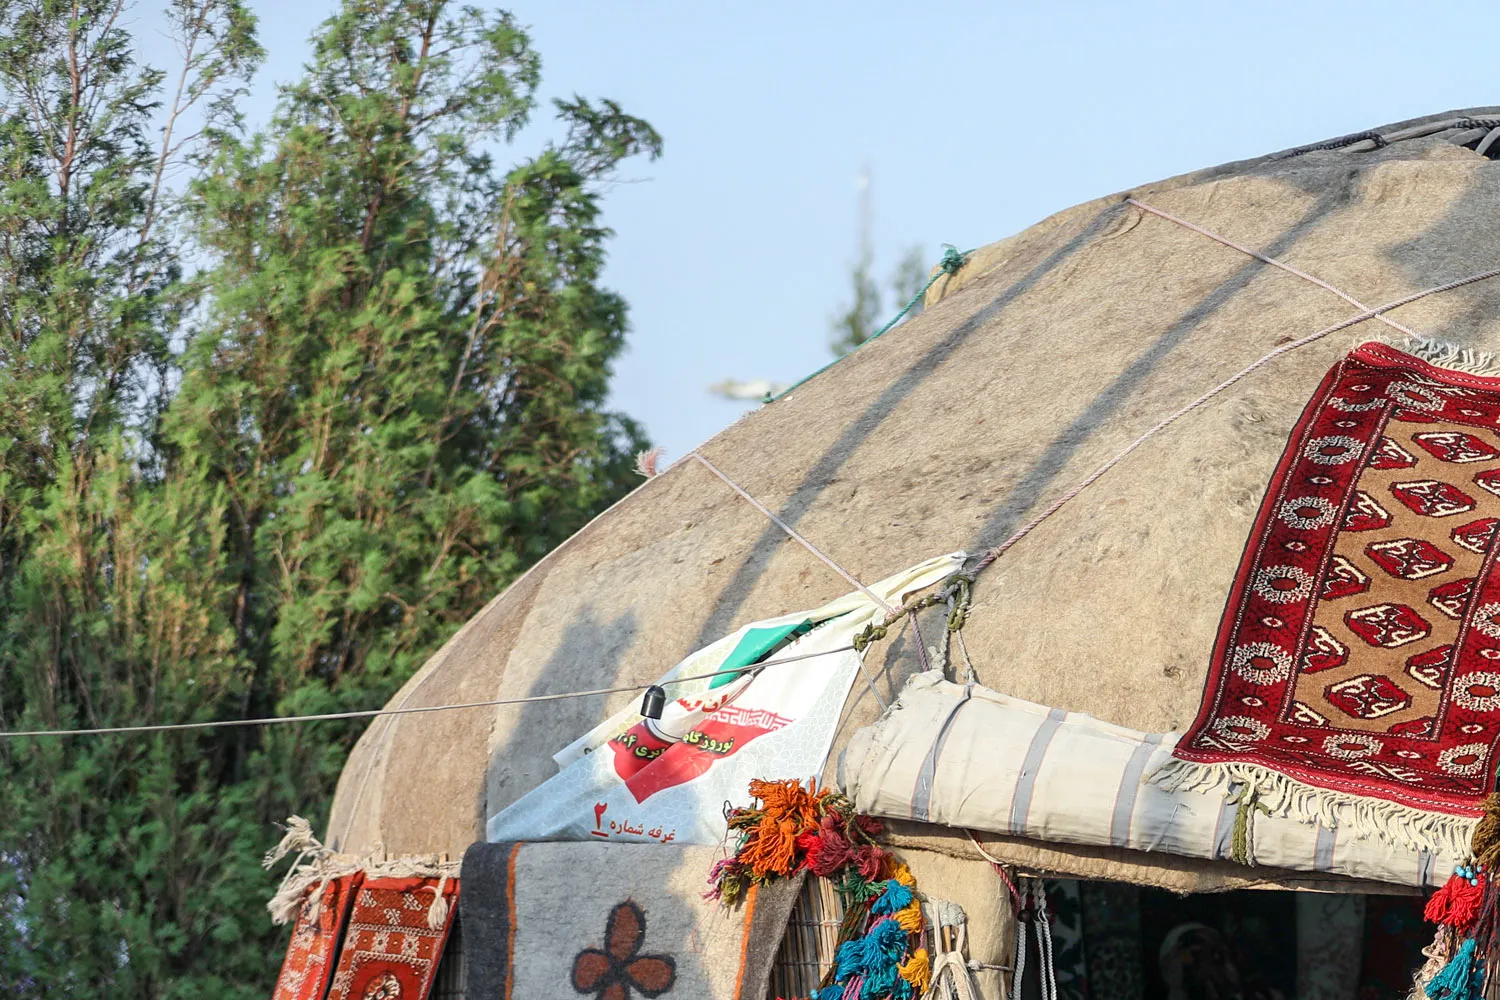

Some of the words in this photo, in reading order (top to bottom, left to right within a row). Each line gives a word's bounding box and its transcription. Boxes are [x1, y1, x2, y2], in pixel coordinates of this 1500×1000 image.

[593, 802, 608, 831] ۲
[610, 819, 644, 836] شماره
[648, 825, 676, 844] غرفه
